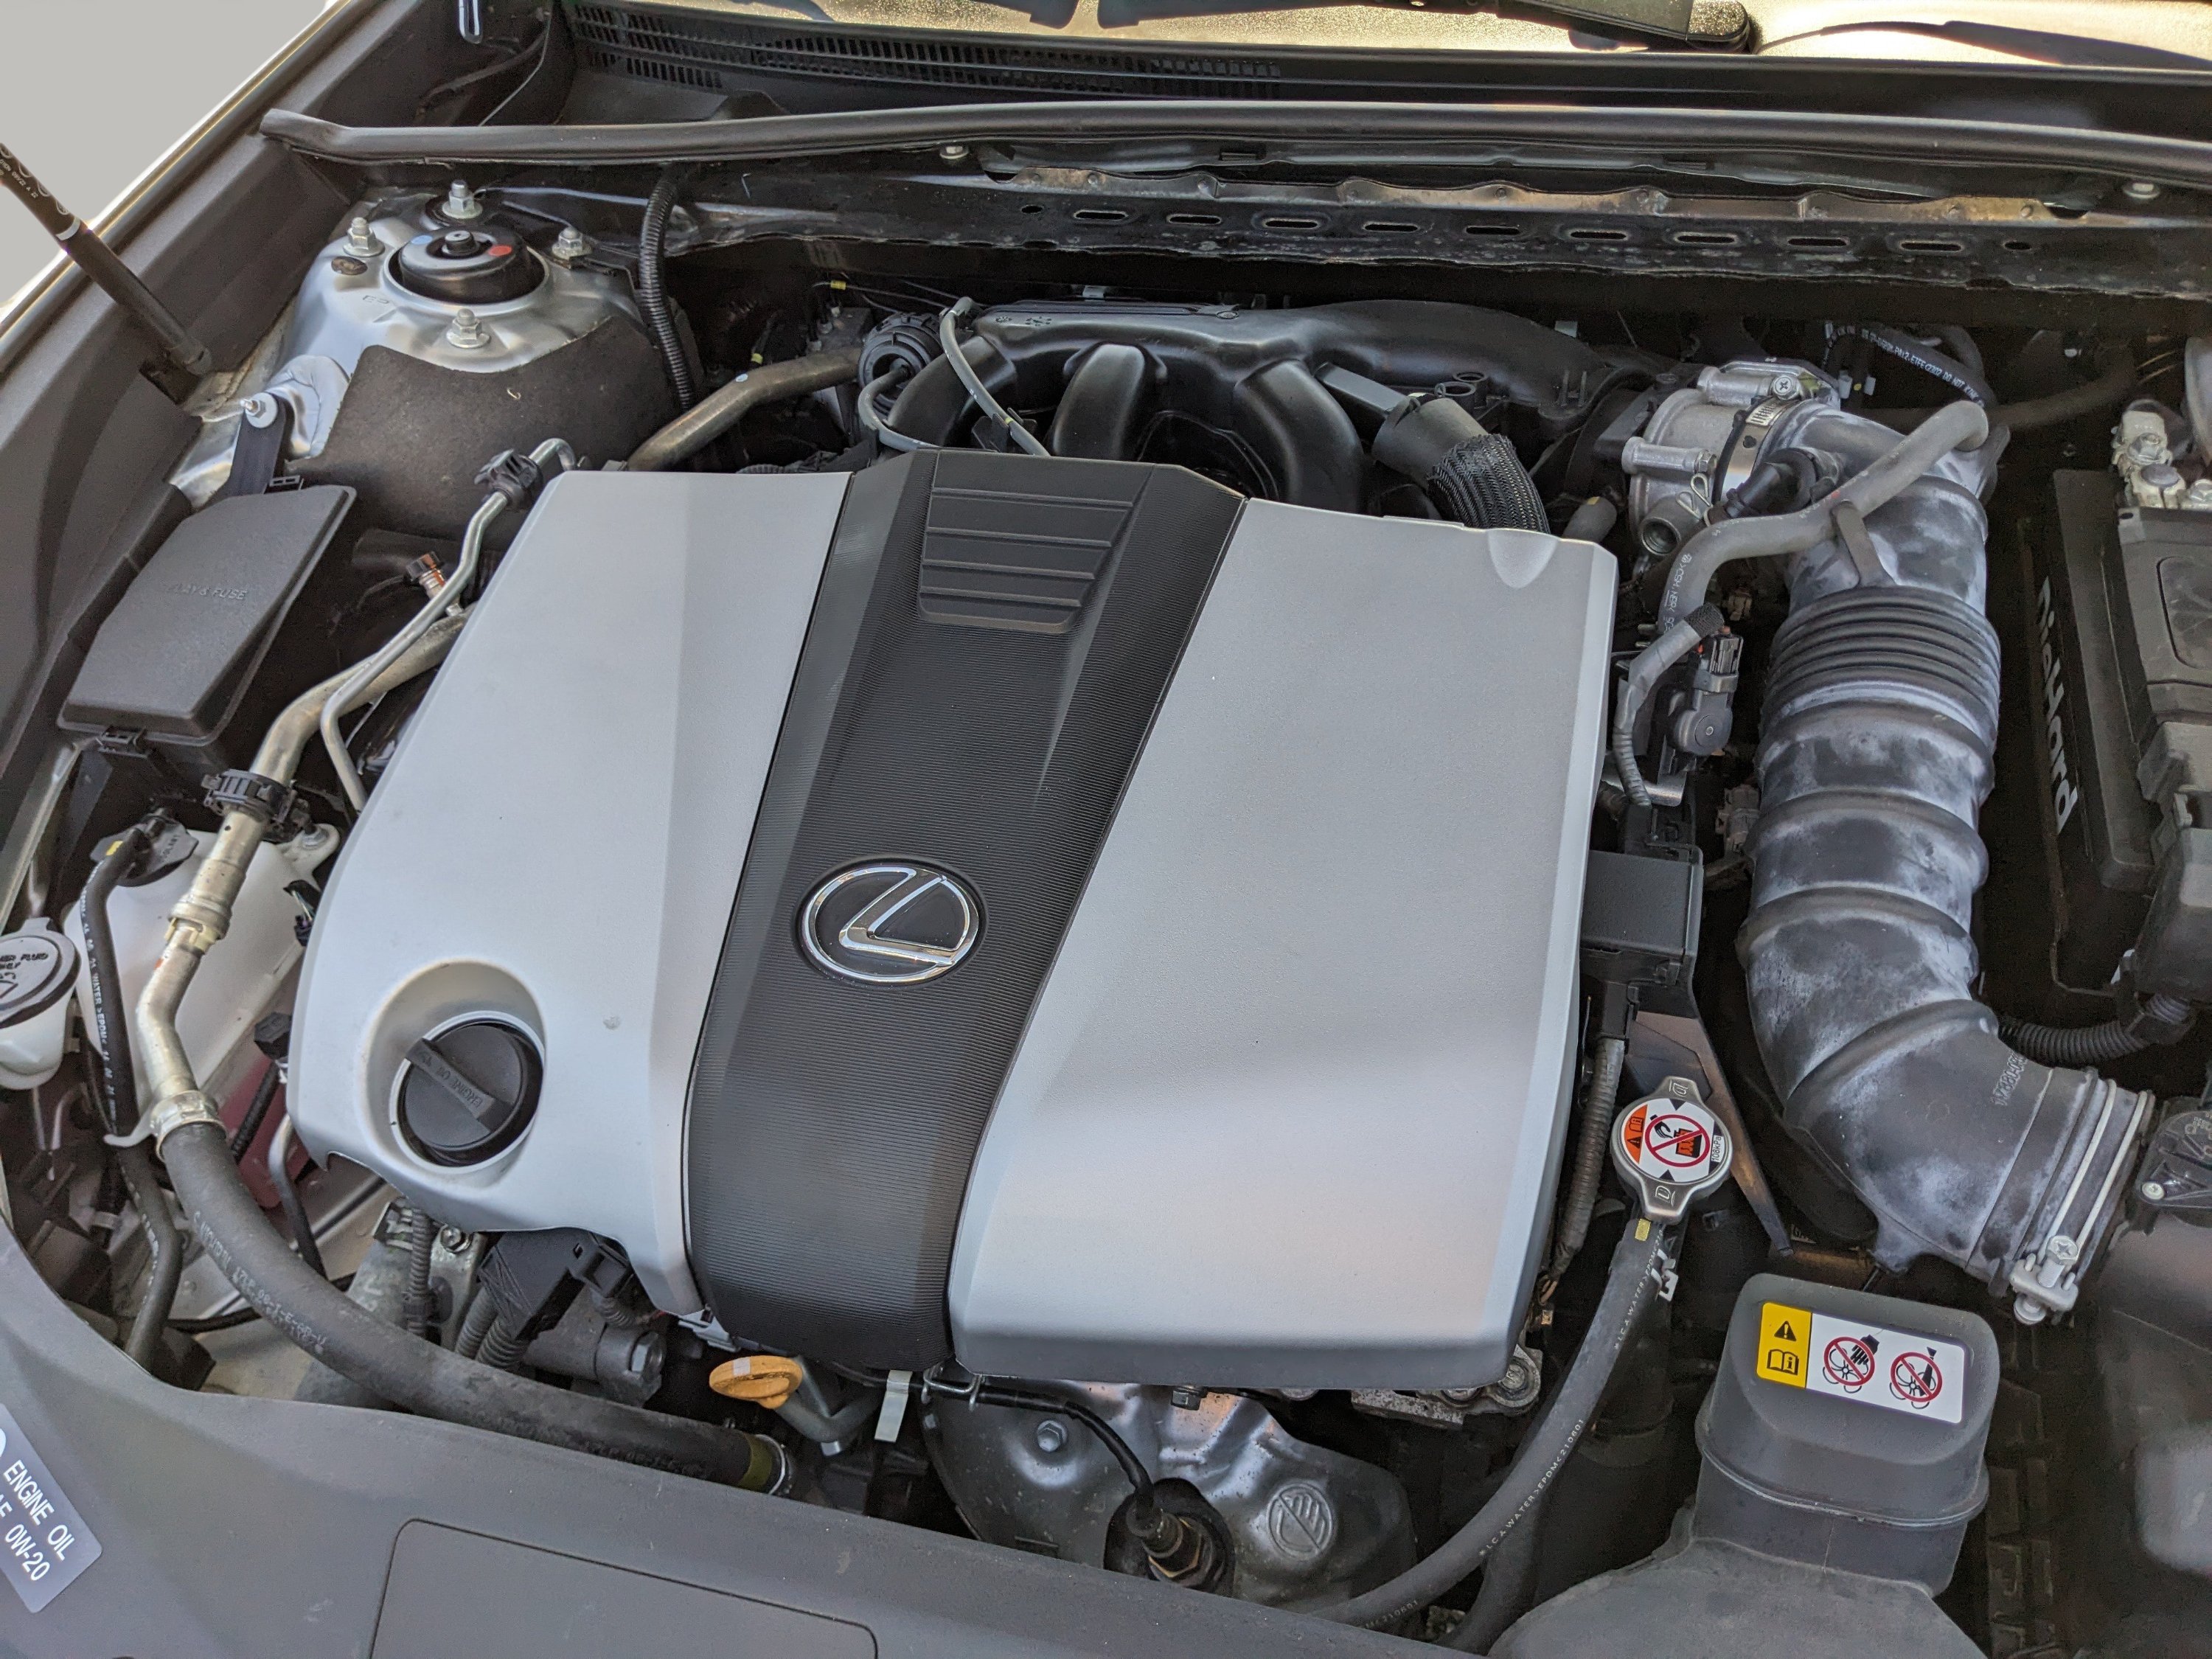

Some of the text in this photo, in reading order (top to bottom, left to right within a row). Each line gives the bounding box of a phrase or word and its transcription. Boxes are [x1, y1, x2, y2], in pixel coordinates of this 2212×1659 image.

[1711, 1136, 1722, 1161] 108kPa
[1627, 1281, 1644, 1315] WATER
[3, 1459, 75, 1561] ENGINE OIL
[1505, 1495, 1535, 1528] WATER
[4, 1523, 50, 1581] 0W-20
